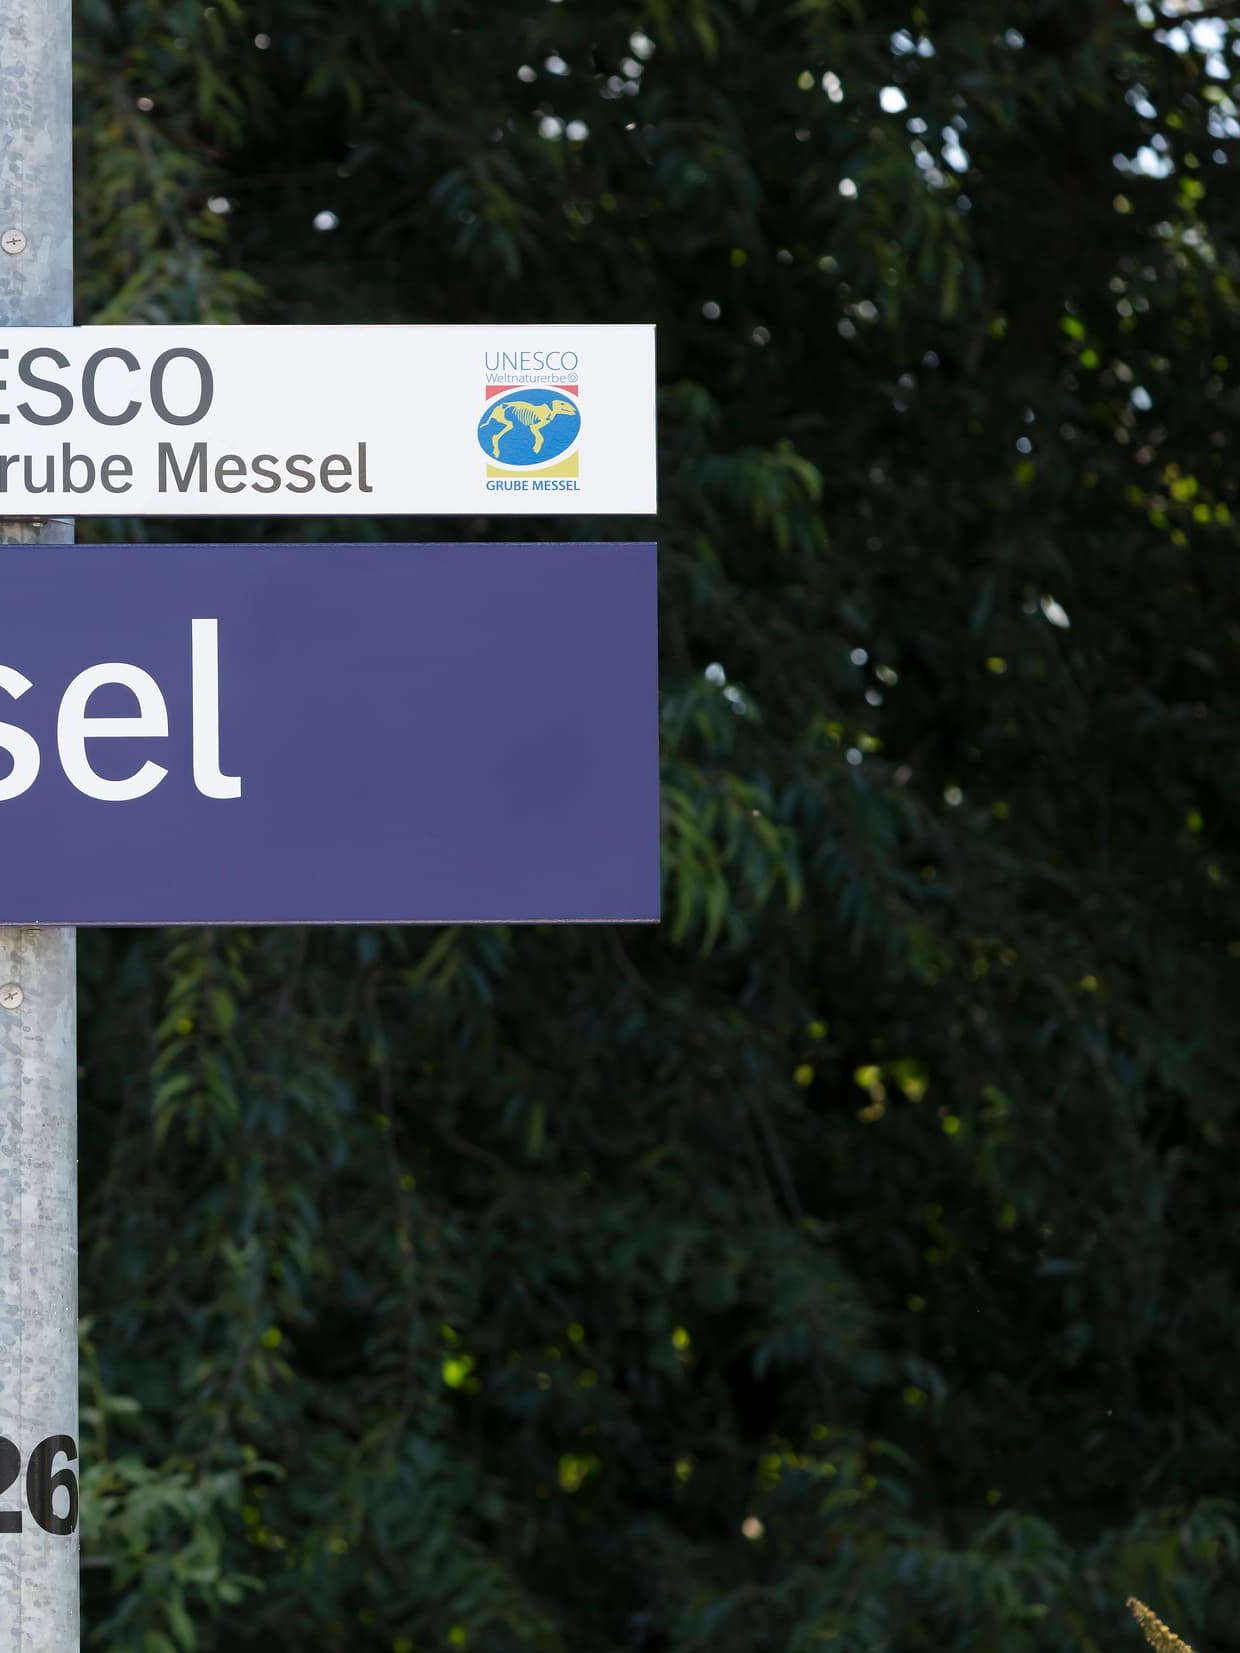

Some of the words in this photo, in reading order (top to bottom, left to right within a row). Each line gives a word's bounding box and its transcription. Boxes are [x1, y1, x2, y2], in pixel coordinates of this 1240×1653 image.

[485, 351, 579, 371] UNESCO
[485, 372, 567, 384] Weltnaturerbe
[158, 441, 373, 494] Messel
[486, 480, 529, 491] GRUBE
[532, 480, 581, 491] MESSEL
